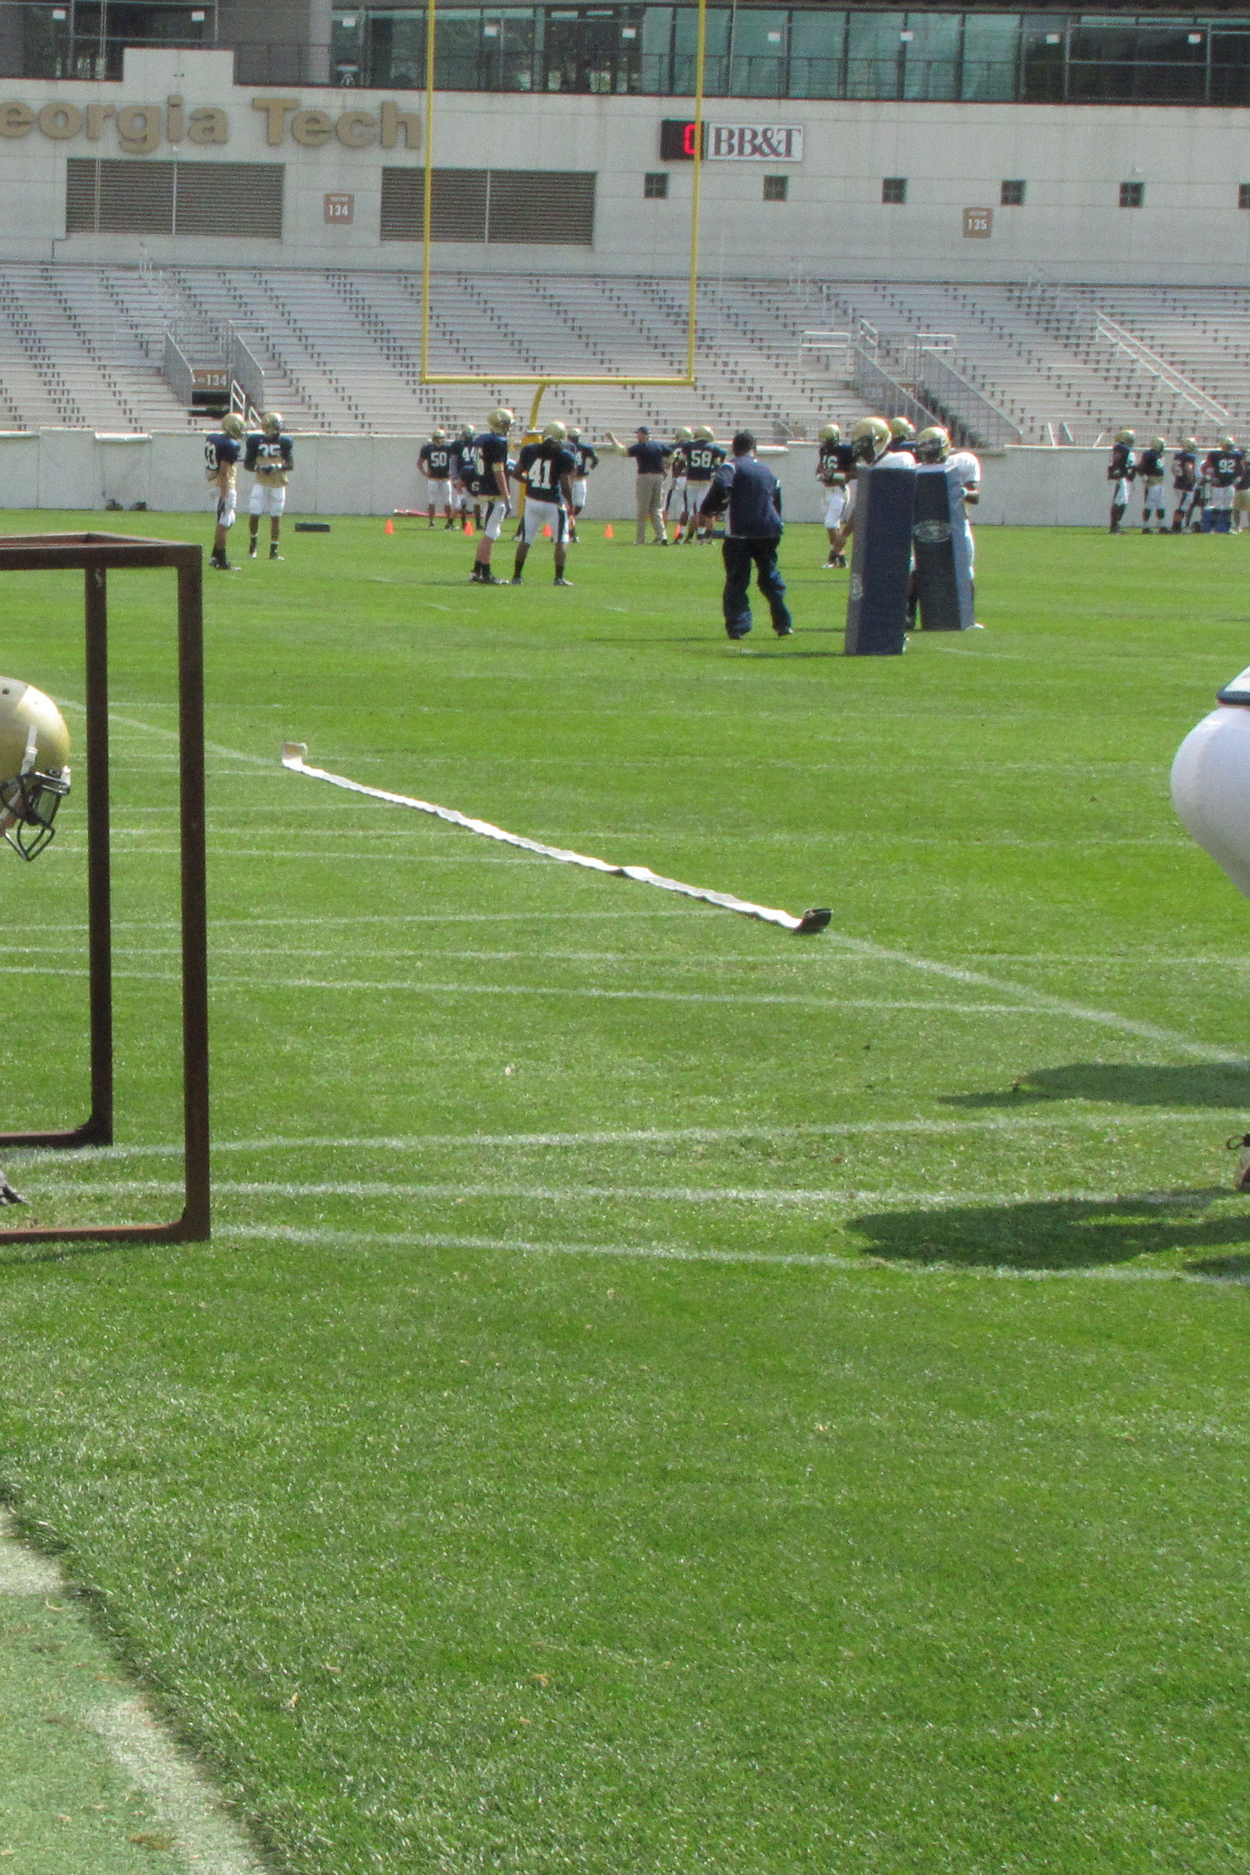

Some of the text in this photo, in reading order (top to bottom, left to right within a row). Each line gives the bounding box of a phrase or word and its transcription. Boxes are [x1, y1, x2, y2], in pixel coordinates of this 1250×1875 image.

[252, 97, 422, 149] Tech
[713, 126, 802, 159] BB&T
[329, 204, 348, 217] 134
[968, 219, 987, 231] 135
[430, 451, 448, 468] 50
[690, 450, 712, 468] 58
[1218, 459, 1235, 474] 92
[527, 458, 551, 489] 41
